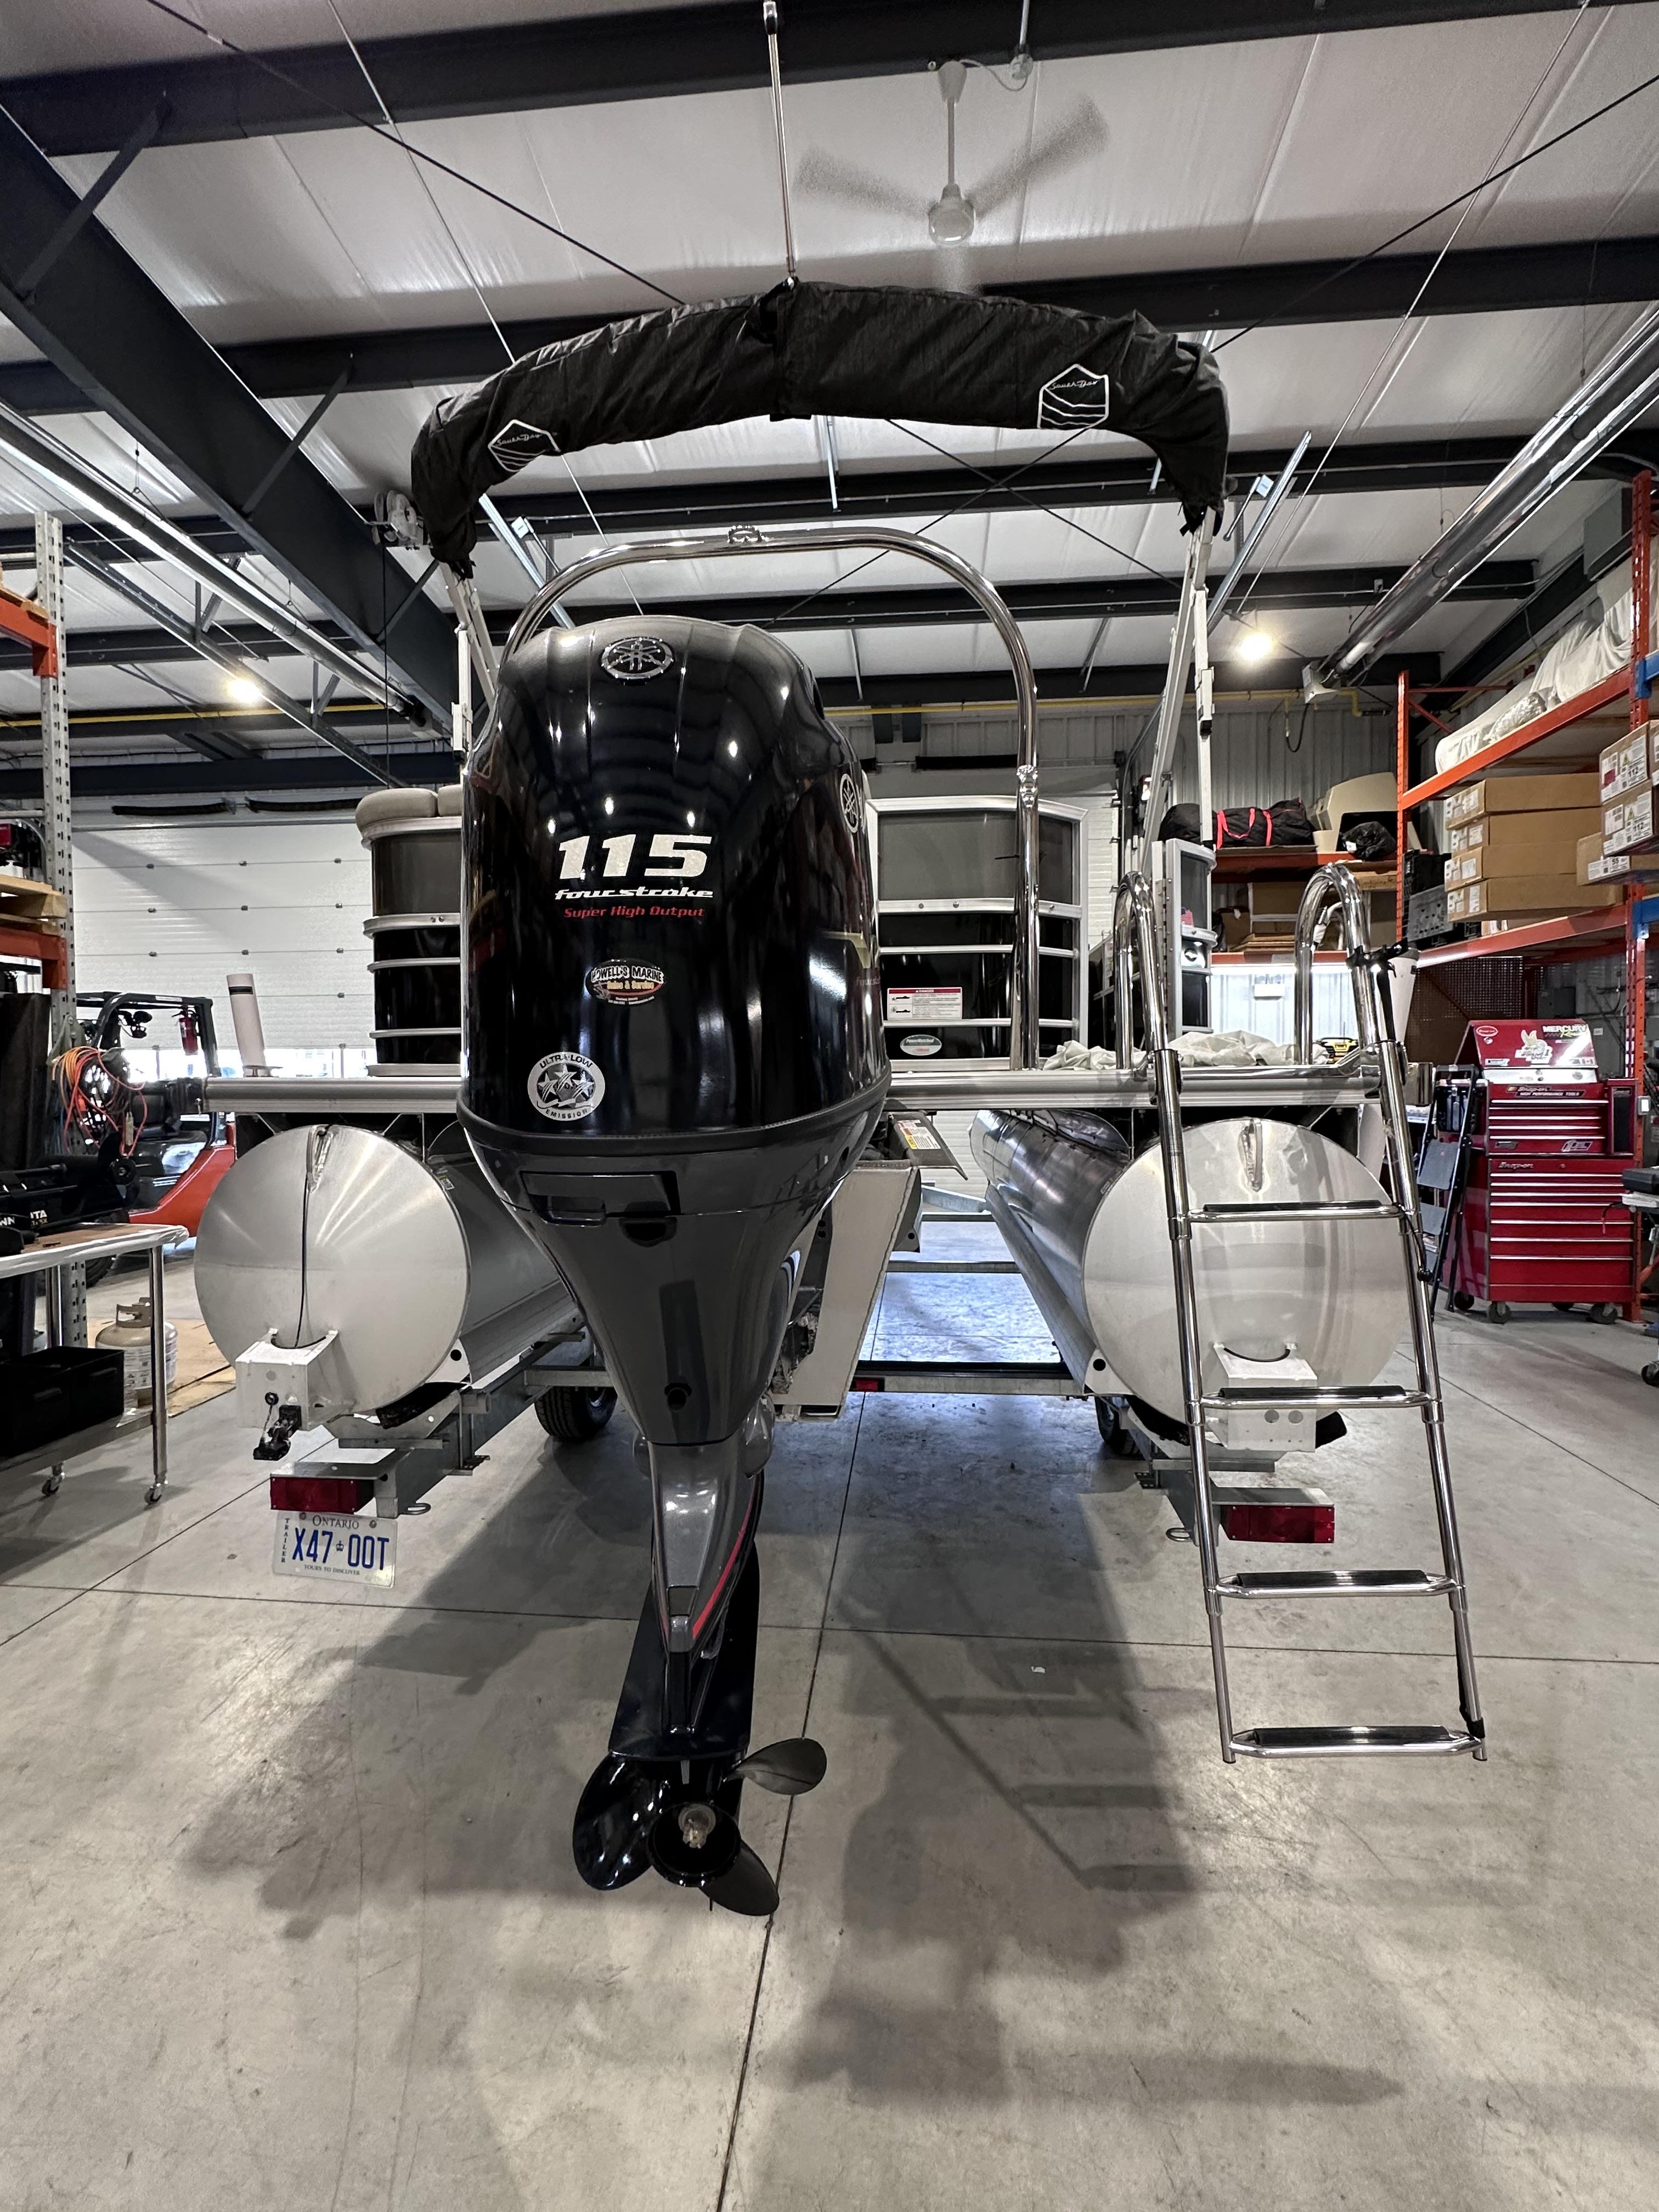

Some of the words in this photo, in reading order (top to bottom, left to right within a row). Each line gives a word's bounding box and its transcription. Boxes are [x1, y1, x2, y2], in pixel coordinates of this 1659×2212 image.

[1633, 822, 1645, 832] 112
[558, 834, 712, 879] 115
[563, 907, 606, 919] Super
[610, 906, 645, 917] High
[650, 906, 706, 918] Output
[631, 965, 664, 984] MARINE
[1542, 1024, 1589, 1032] MERCURY
[571, 1054, 593, 1068] LOW
[545, 1108, 588, 1119] EMISSION
[312, 1514, 359, 1530] ONTARIO
[281, 1517, 290, 1563] TRAILER
[292, 1527, 333, 1564] X47
[332, 1567, 360, 1576] DISCOVER
